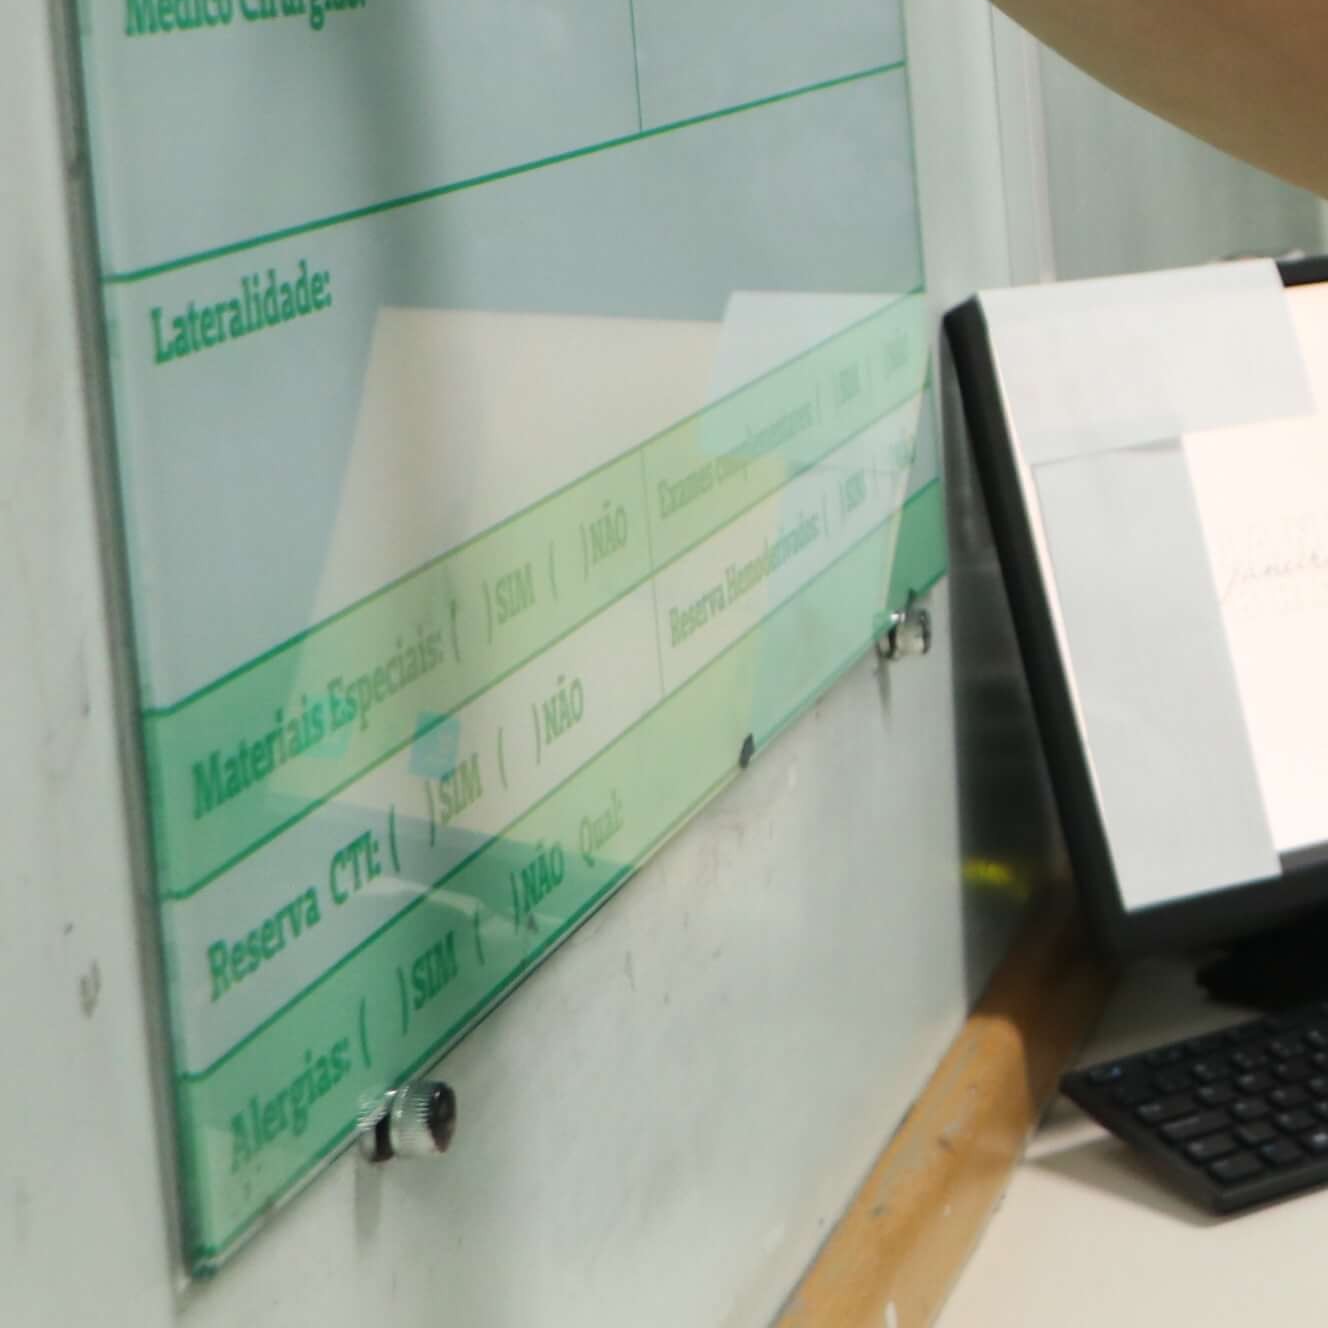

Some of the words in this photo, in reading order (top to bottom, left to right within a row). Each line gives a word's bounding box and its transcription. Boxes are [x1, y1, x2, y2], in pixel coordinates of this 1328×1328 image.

[150, 258, 333, 365] Lateralidade:
[191, 694, 327, 821] Materiais
[326, 626, 444, 732] Especiais:
[495, 561, 537, 625] SIM
[206, 885, 321, 1003] Reserva
[438, 752, 483, 827] SIM
[229, 1035, 352, 1171] Alergias:
[411, 929, 459, 1012] SIM
